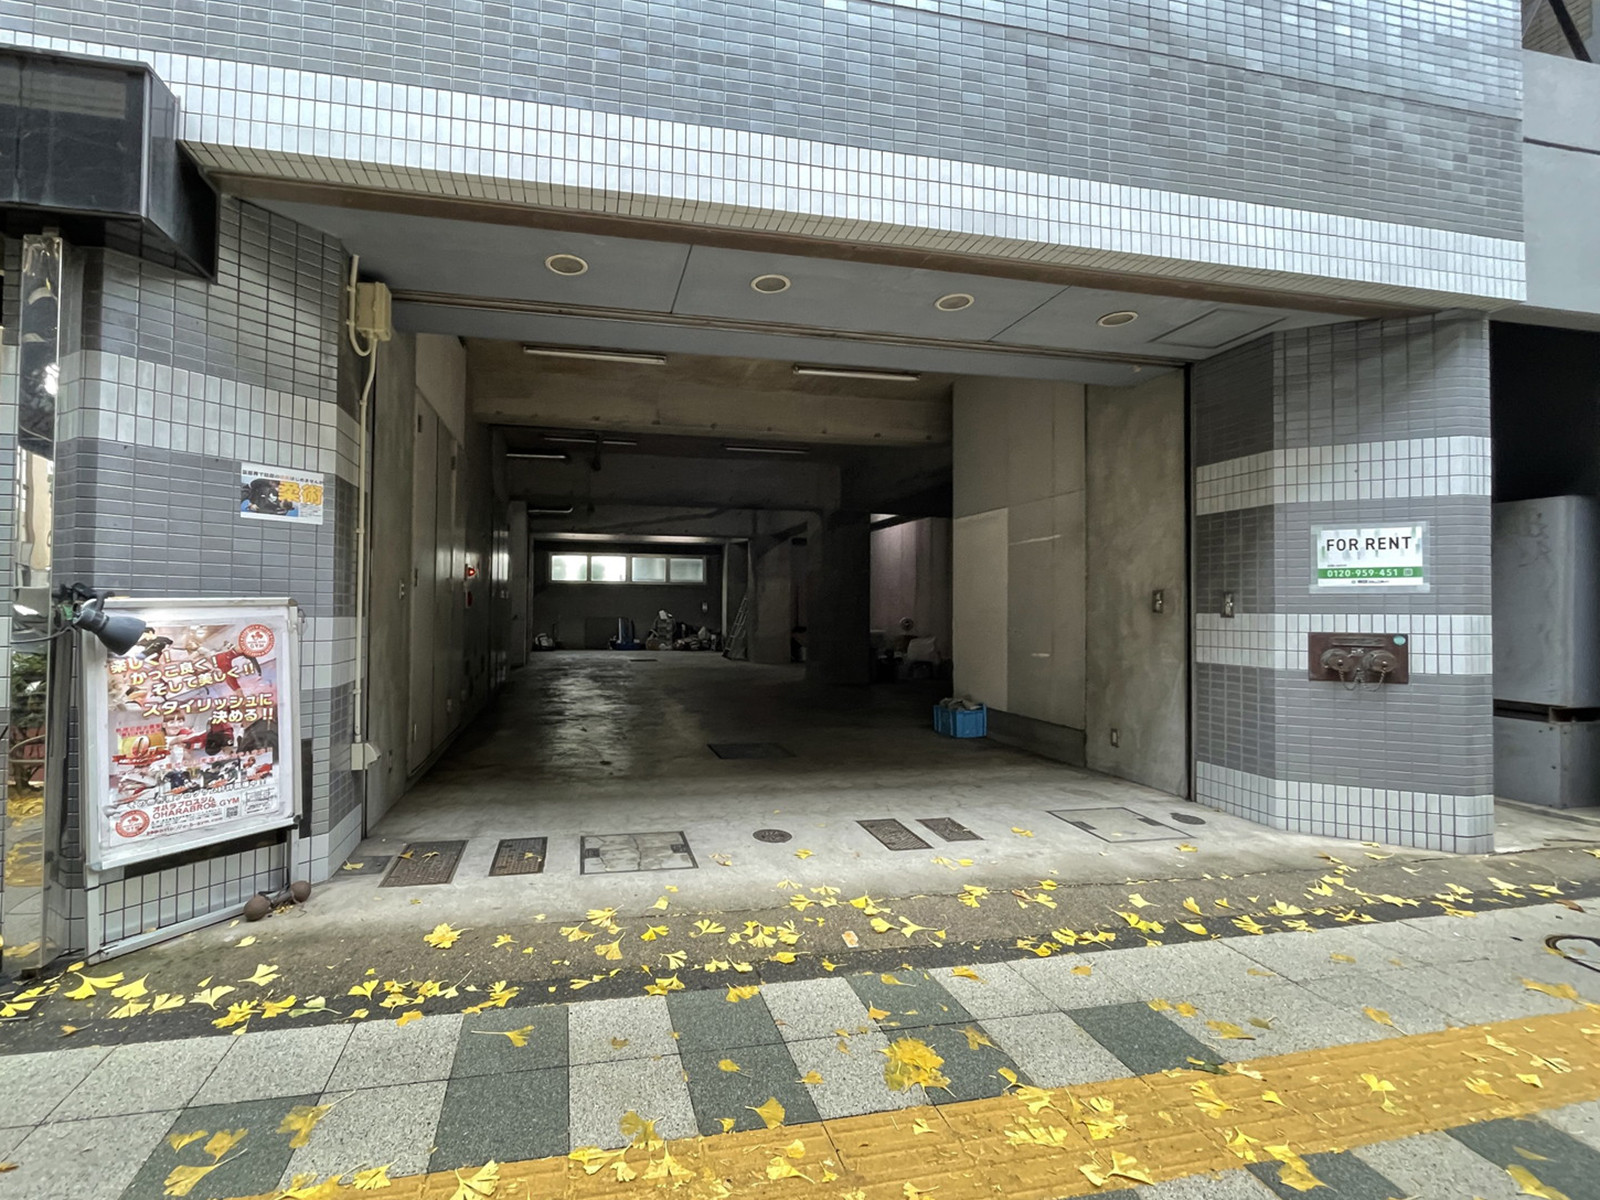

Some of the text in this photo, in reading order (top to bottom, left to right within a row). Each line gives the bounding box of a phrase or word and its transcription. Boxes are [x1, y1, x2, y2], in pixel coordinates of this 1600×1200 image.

[1327, 536, 1411, 551] FOR RENT
[143, 693, 272, 717] スタイリッシュに
[153, 802, 216, 820] OHARABROS
[219, 797, 239, 807] GYM
